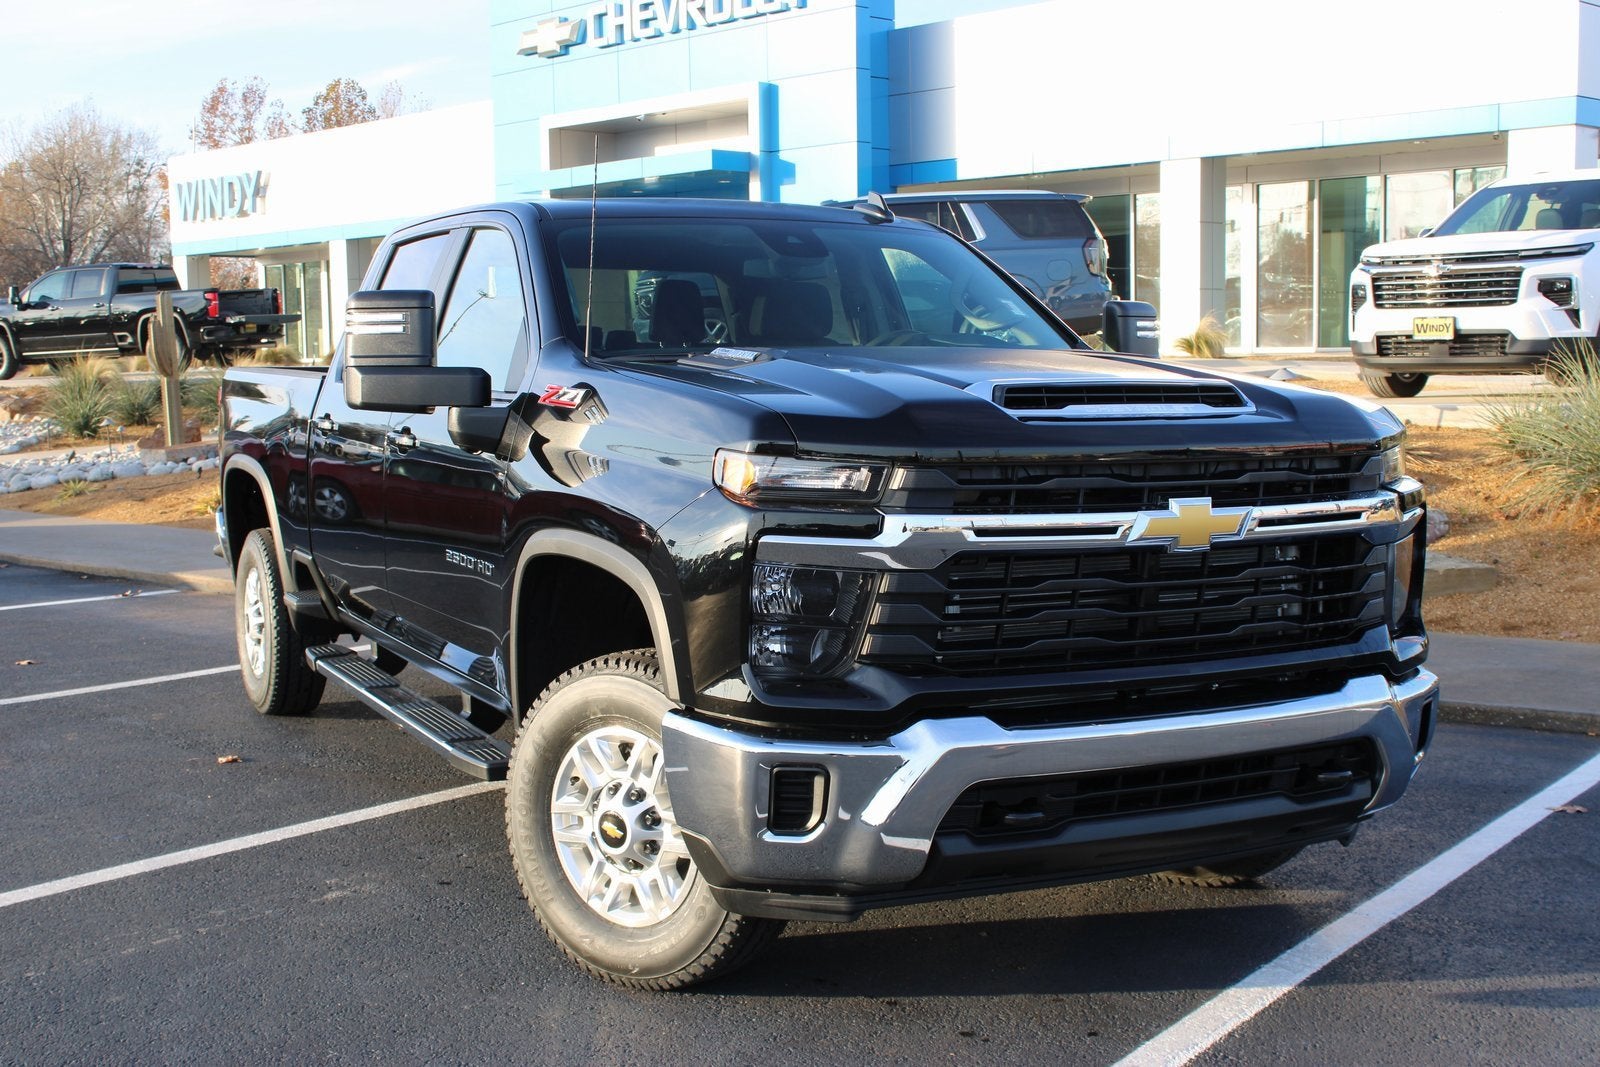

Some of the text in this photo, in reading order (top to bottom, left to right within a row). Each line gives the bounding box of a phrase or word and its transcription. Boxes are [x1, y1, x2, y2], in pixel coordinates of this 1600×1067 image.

[177, 171, 262, 222] WINDY
[1416, 323, 1452, 334] WINDY
[537, 384, 592, 410] Z71
[445, 549, 493, 576] 2500 HD
